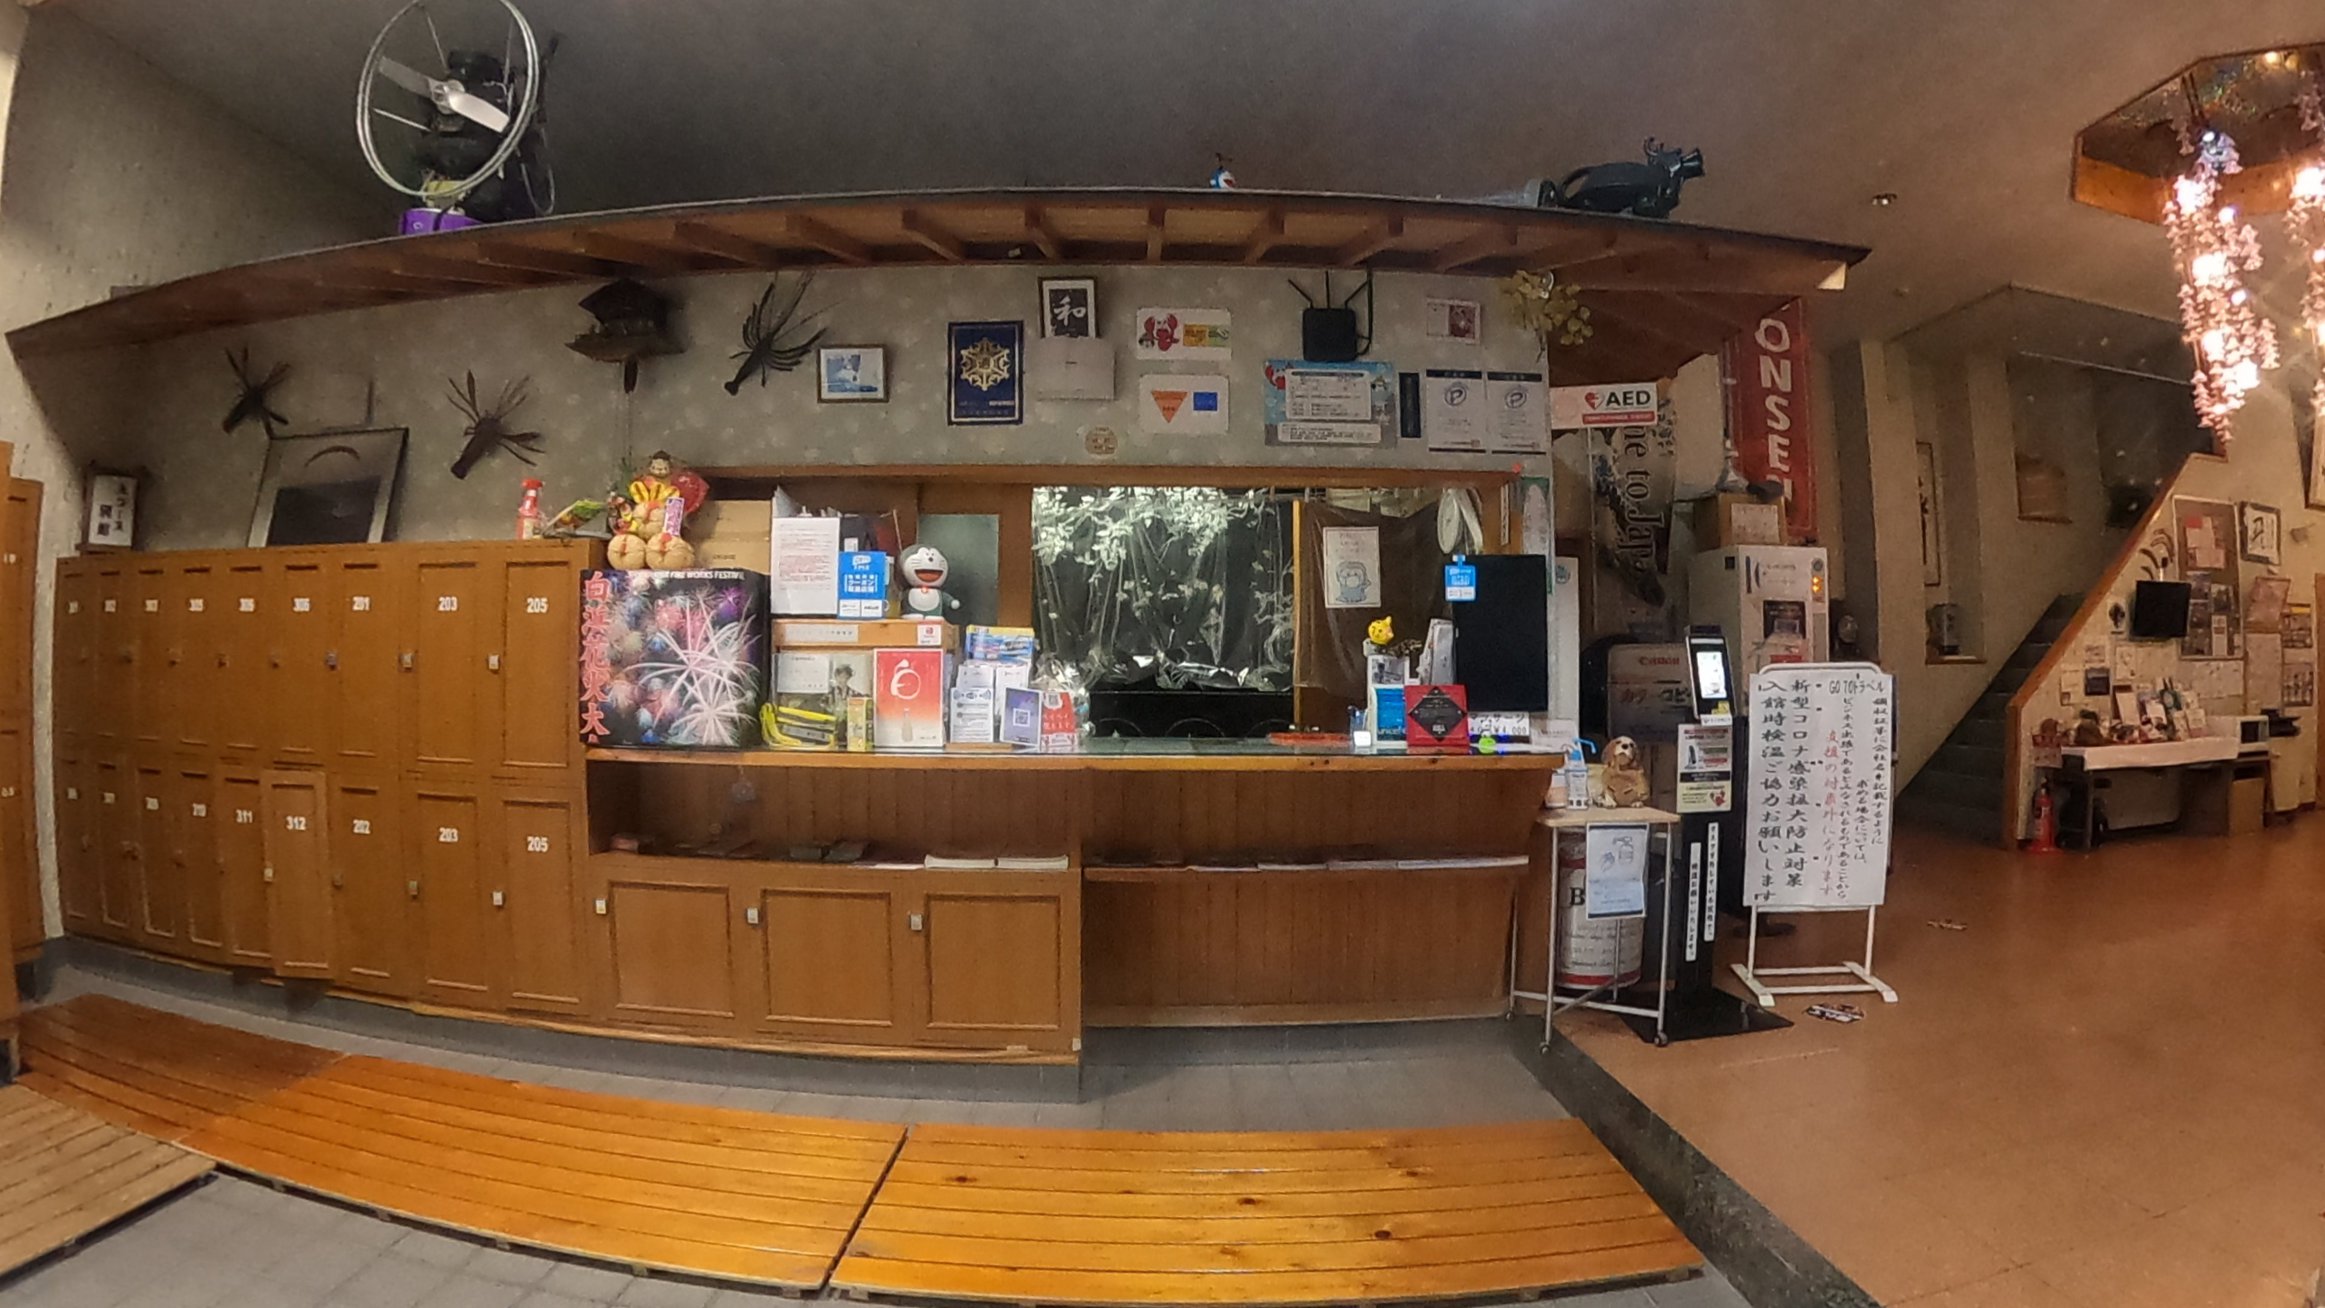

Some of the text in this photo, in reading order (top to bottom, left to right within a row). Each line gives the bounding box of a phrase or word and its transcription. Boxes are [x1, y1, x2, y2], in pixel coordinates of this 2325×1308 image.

[1053, 296, 1086, 326] 和
[1606, 391, 1651, 406] AED
[352, 596, 371, 611] 201
[438, 597, 458, 611] 203
[526, 598, 548, 613] 205
[1639, 656, 1680, 666] Canon
[1757, 680, 1788, 902] 入館時検温ご協力お願いします
[1784, 680, 1812, 887] 新型コロナ感染拡大防止対策
[236, 809, 253, 823] 311
[285, 816, 307, 831] 312
[352, 819, 371, 834] 202
[438, 827, 459, 843] 203
[526, 836, 549, 852] 205
